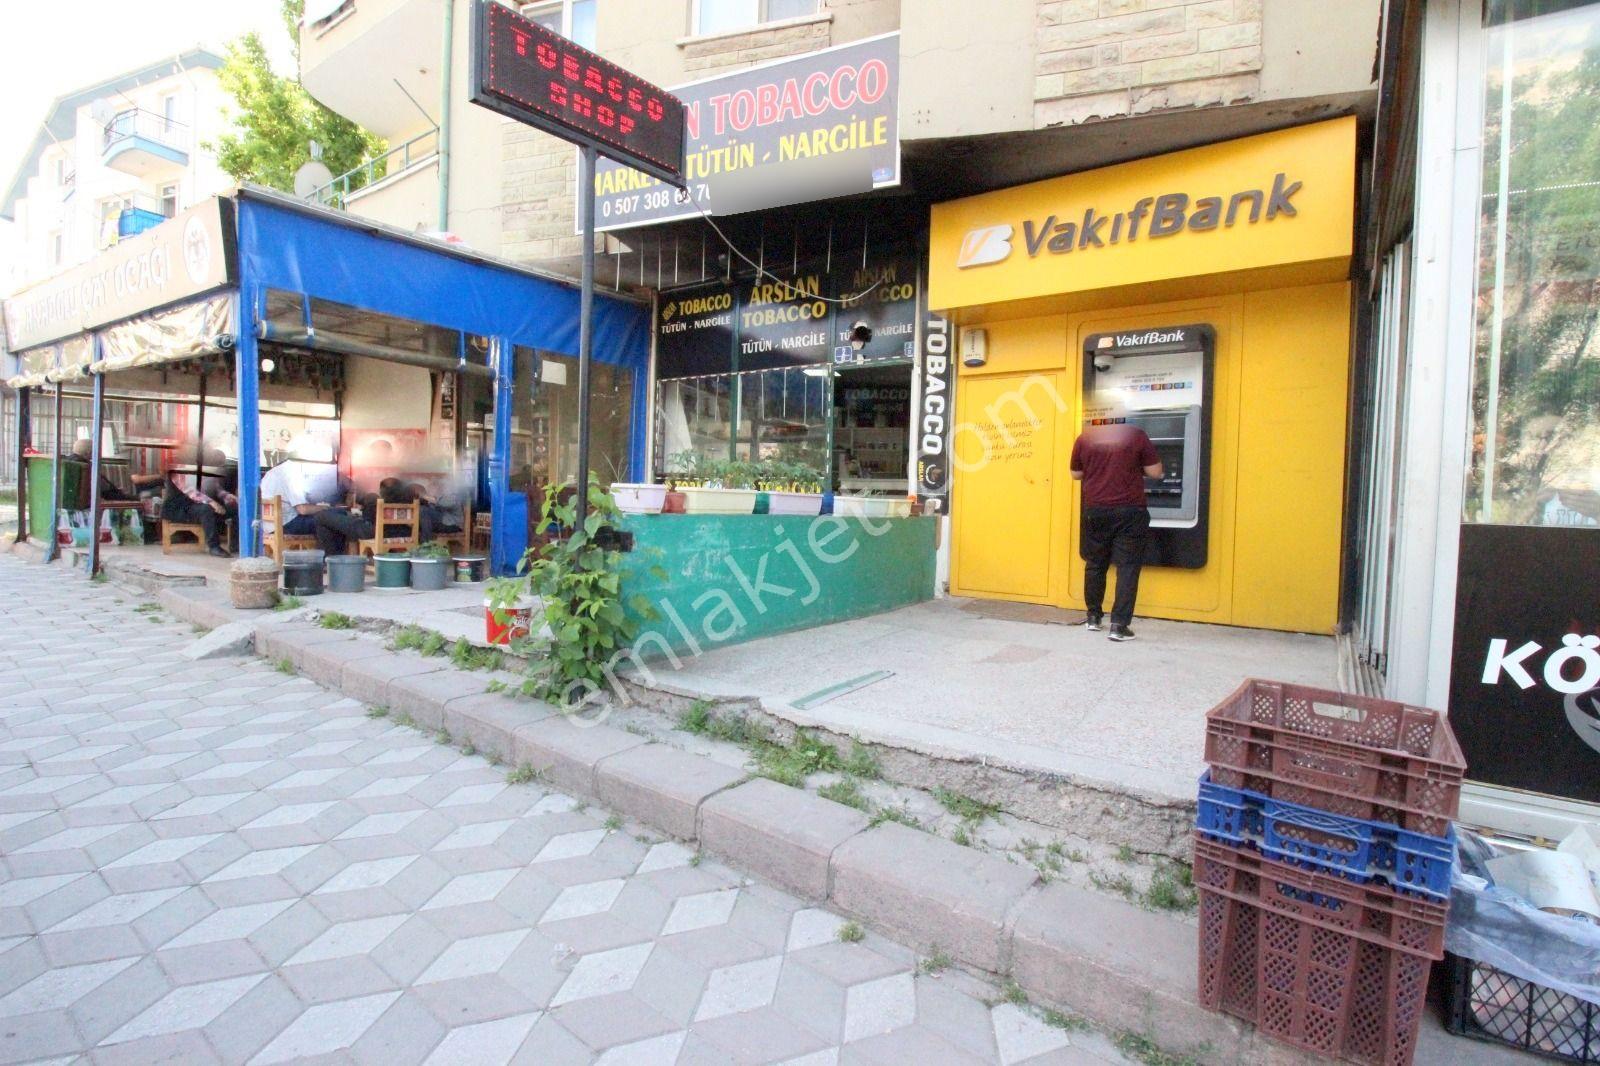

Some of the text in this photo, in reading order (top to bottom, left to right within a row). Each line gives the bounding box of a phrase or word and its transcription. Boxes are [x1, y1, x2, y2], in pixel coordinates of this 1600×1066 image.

[511, 26, 664, 122] TOBACCO
[550, 81, 636, 135] SHOP
[709, 58, 889, 136] TOBACCO
[686, 139, 754, 180] TÜTÜN
[778, 115, 888, 162] NARGİLE
[602, 200, 611, 217] 0
[614, 195, 640, 215] 507
[643, 190, 670, 210] 308
[1022, 173, 1304, 258] VakıfBank
[678, 292, 732, 316] TOBACCO
[749, 274, 819, 307] ARSLAN
[661, 315, 731, 335] TÜTÜN NARGİLE
[742, 301, 827, 329] TOBACCO
[874, 322, 913, 336] NARGİLE
[741, 337, 772, 354] TÜTÜN
[781, 331, 826, 350] NARGİLE
[1116, 329, 1185, 347] VakıfBank
[922, 317, 948, 455] TOBACCO
